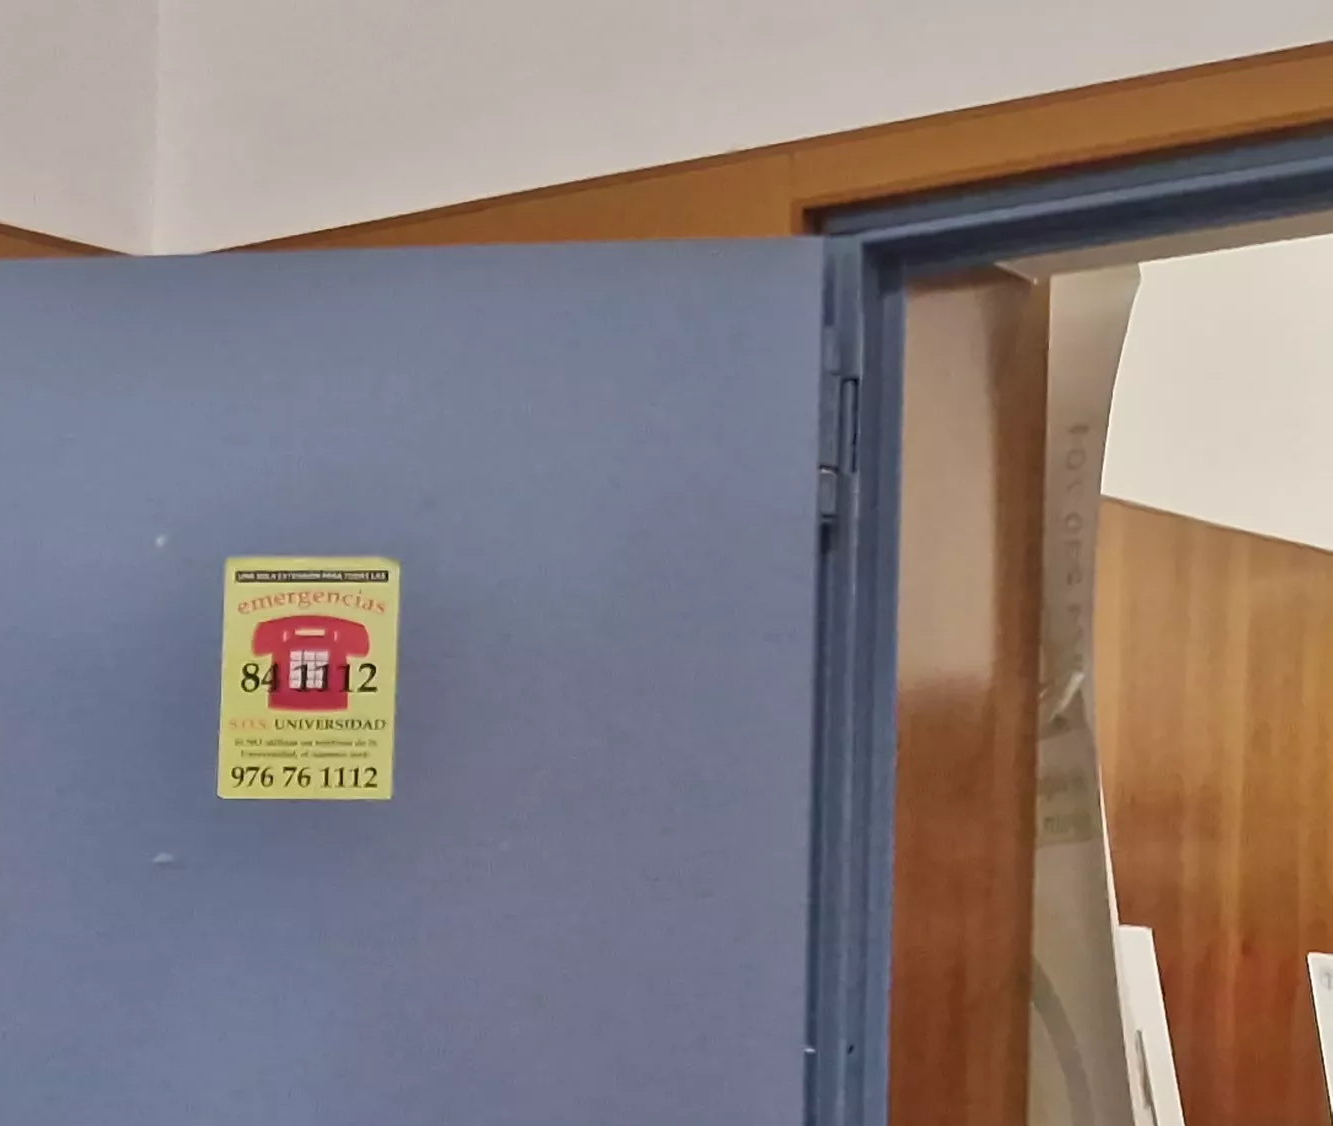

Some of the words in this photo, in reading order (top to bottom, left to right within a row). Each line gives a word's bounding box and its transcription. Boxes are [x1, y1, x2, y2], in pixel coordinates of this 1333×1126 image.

[237, 588, 388, 615] emergencias
[240, 662, 280, 694] 84
[274, 718, 387, 731] UNIVERSIDAD
[231, 765, 274, 789] 976
[282, 765, 312, 789] 76
[320, 765, 379, 789] 1112
